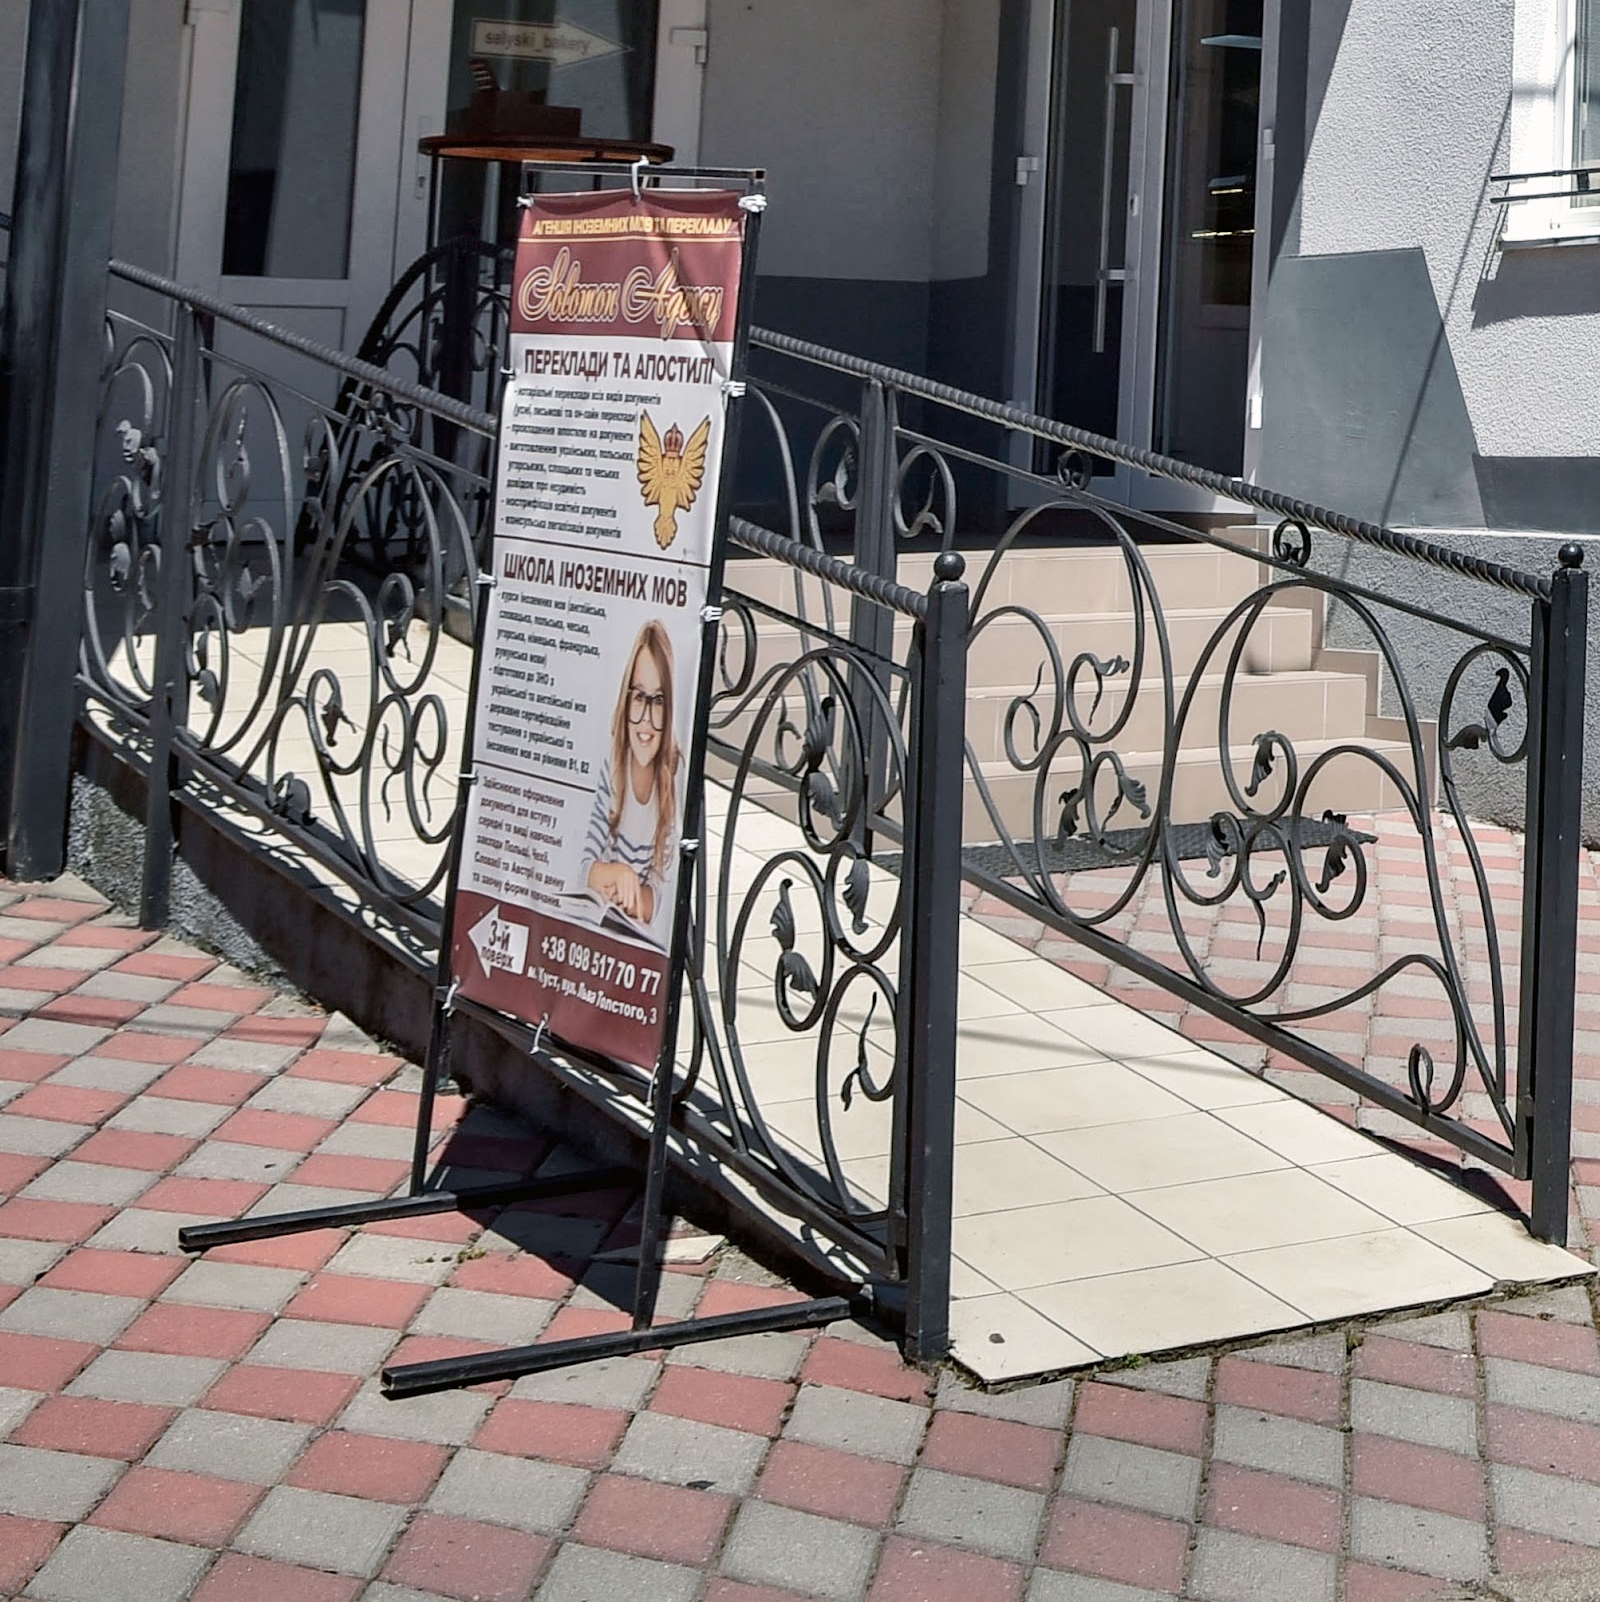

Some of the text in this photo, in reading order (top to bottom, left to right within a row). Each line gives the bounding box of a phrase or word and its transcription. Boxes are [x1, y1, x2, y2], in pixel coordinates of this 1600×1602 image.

[666, 217, 733, 235] ПЕРЕКЛАДУ
[519, 246, 724, 344] Solomon Agency
[524, 349, 715, 385] ПЕРЕКЛАДИ ТА АПОСТИЛІ
[504, 553, 688, 607] ШКОЛА ІНОЗЕМНИХ МОВ
[488, 919, 511, 952] 3-й
[480, 945, 515, 970] поверх
[541, 934, 662, 996] +38 098 517 70 77
[596, 989, 648, 1026] Толстого,
[649, 1007, 658, 1025] 3
